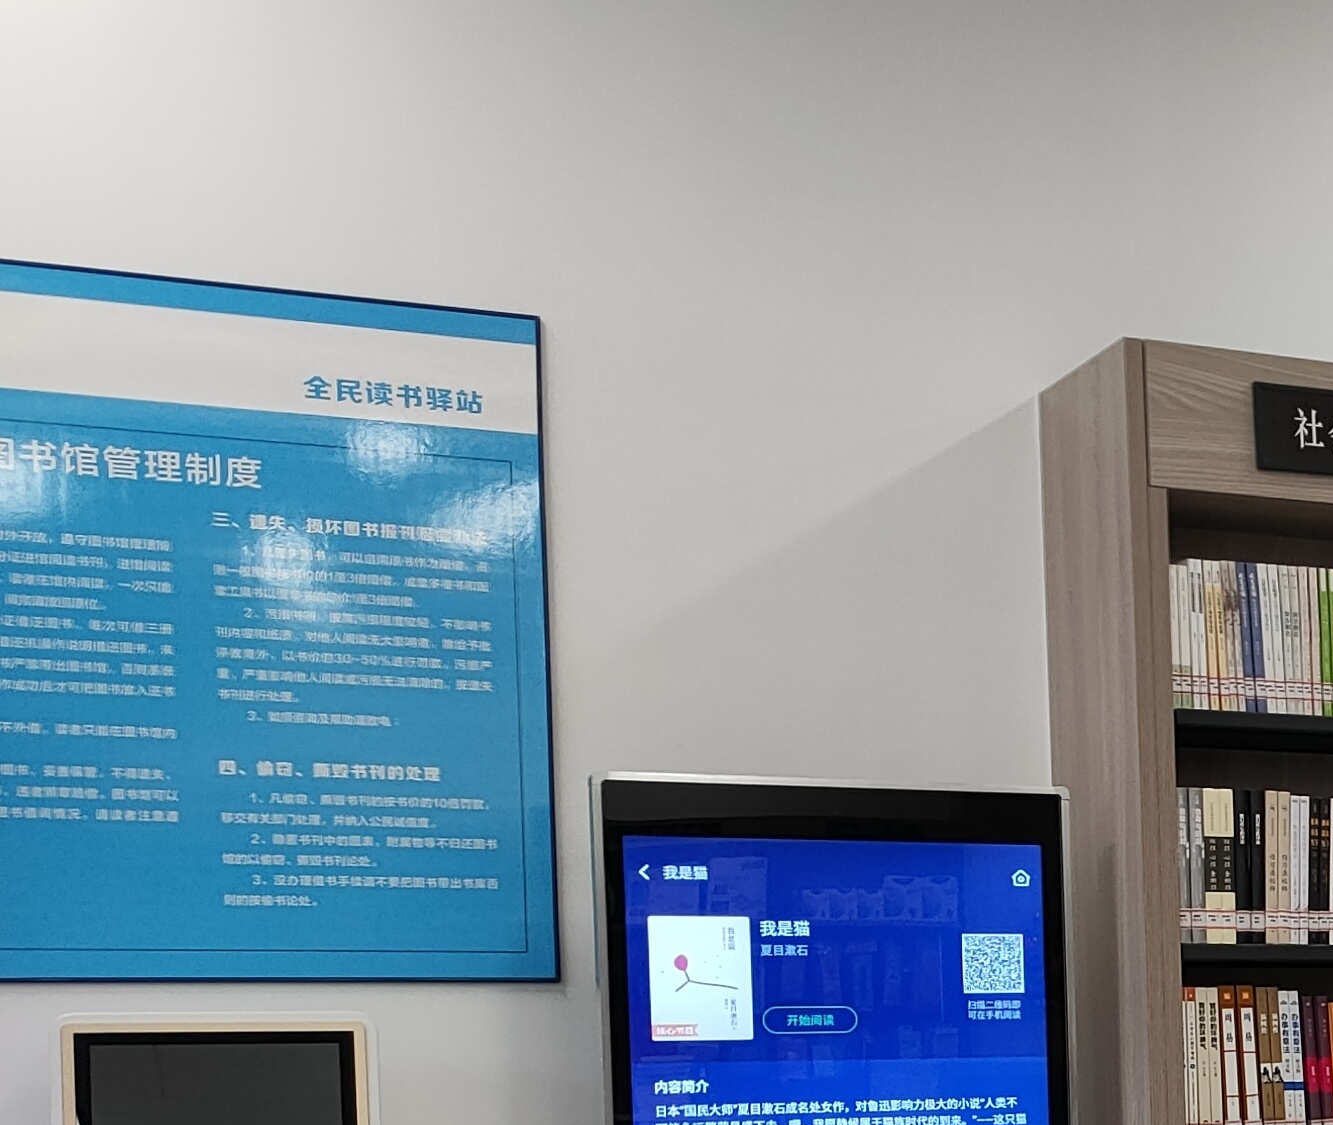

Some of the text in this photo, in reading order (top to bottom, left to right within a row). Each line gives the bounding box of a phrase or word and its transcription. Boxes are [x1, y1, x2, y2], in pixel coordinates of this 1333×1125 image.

[303, 375, 484, 414] 全民读书驿站
[662, 865, 708, 881] 我是猫
[760, 920, 810, 938] 我是猫
[760, 944, 809, 957] 夏目漱石
[786, 1013, 835, 1027] 开始阅读
[968, 1010, 1021, 1020] 可在手机阅读
[654, 1079, 709, 1095] 内容简介
